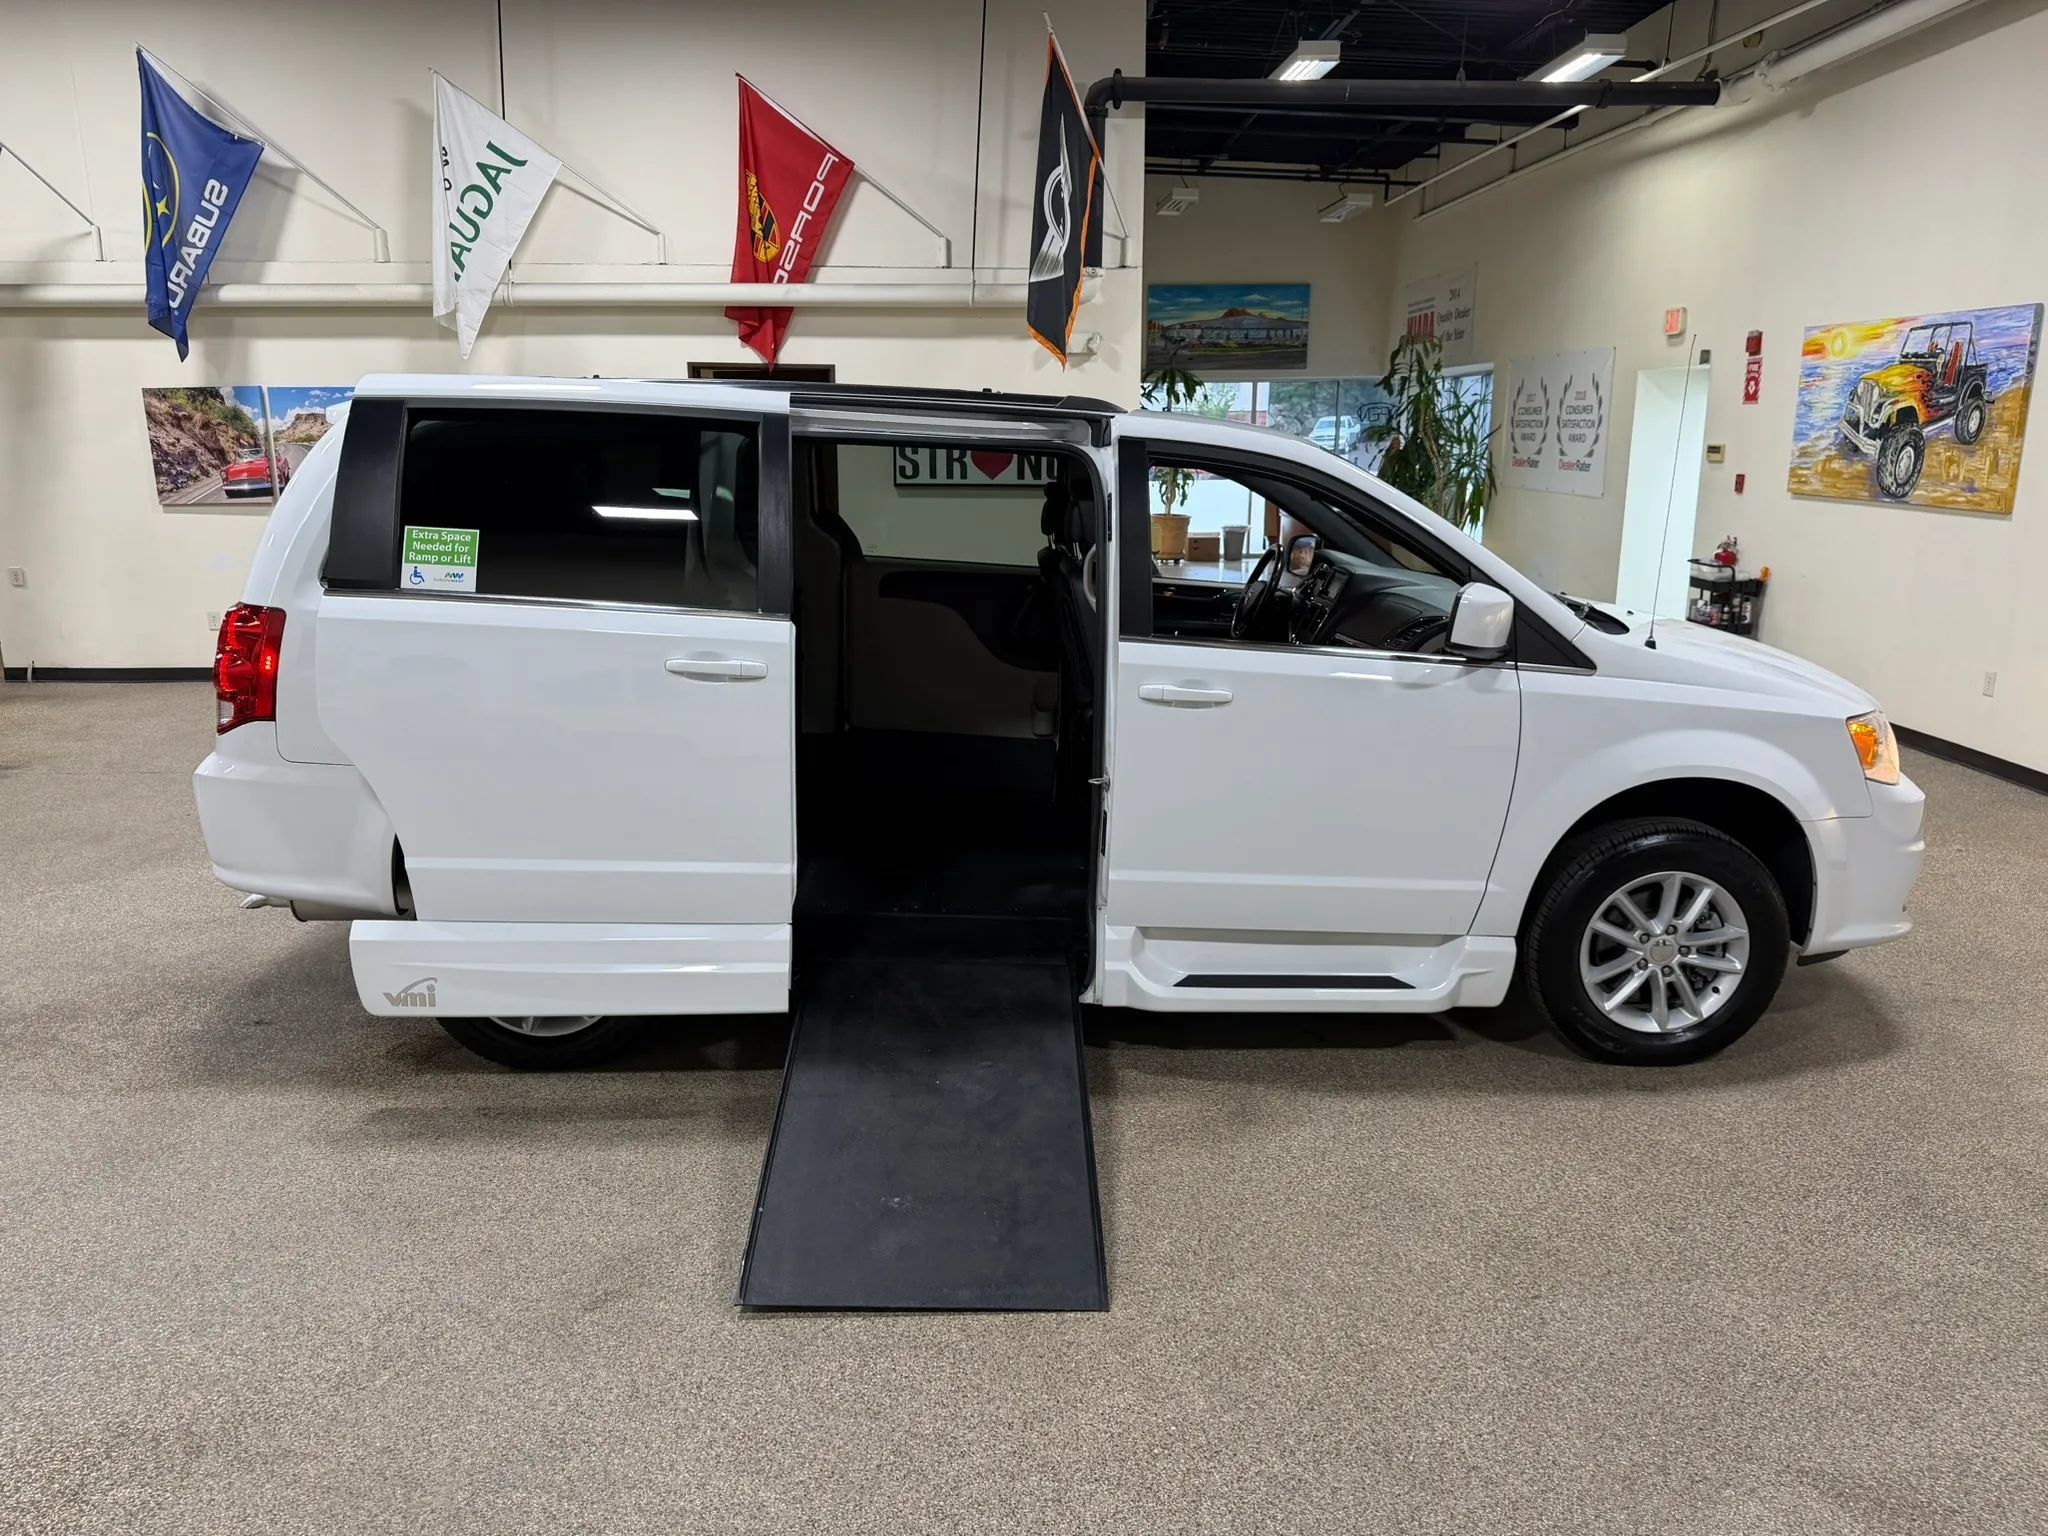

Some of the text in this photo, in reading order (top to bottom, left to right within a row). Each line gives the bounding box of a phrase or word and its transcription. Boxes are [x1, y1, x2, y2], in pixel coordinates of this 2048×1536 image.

[1565, 404, 1594, 416] CONSUMER
[1561, 419, 1596, 429] SATISFACTION
[1567, 433, 1588, 443] AWARD
[412, 529, 472, 542] Extra Space
[412, 541, 470, 553] Needed for
[408, 551, 472, 564] Ramp or Lift
